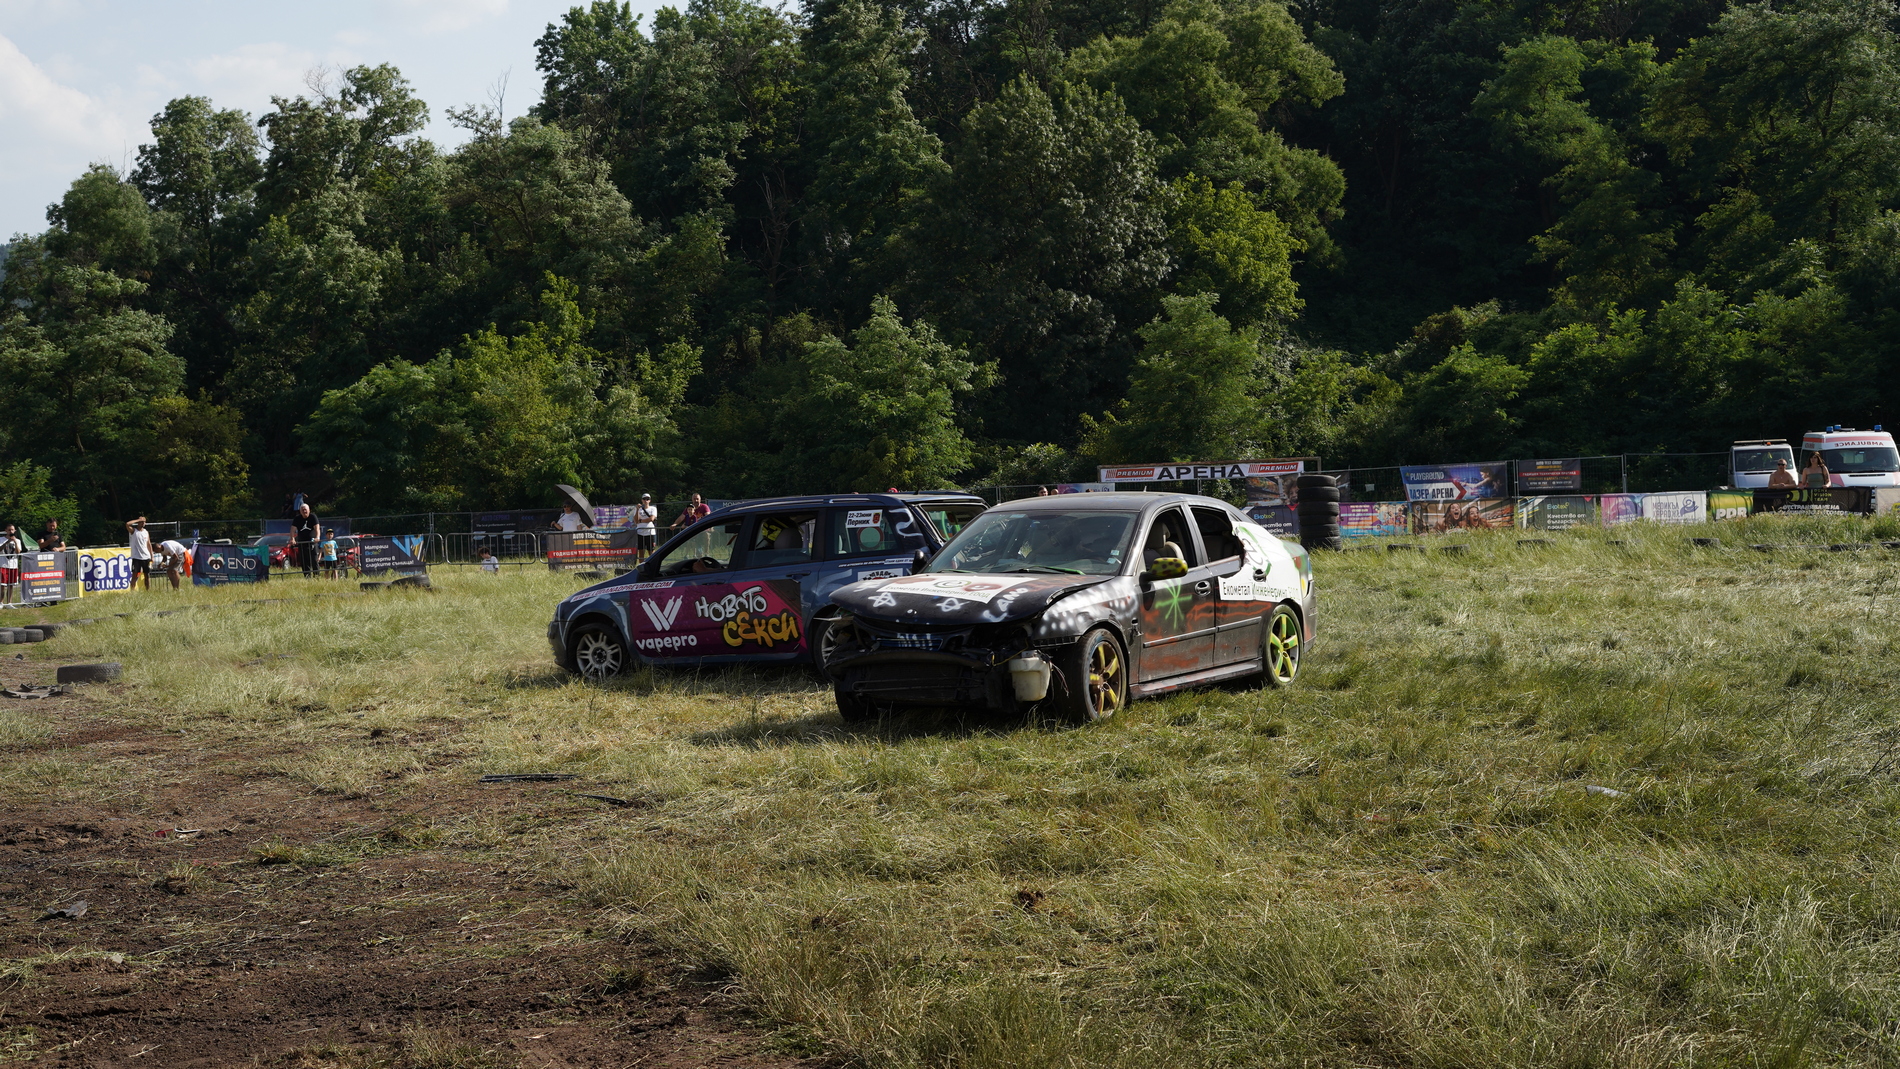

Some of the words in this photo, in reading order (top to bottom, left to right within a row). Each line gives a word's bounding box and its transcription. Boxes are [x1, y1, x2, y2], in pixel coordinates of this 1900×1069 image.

[1157, 464, 1245, 480] АРЕНА
[1259, 464, 1297, 472] PREMIUM
[1410, 471, 1445, 480] PLAYGROUND
[1432, 487, 1454, 499] АРЕНА
[1715, 507, 1748, 520] PDR
[227, 557, 257, 570] ENO
[85, 579, 128, 590] DRINKS
[1222, 581, 1250, 596] Екометал
[695, 586, 767, 622] НОВОТО
[722, 612, 799, 648] СЕКСИ
[635, 634, 698, 652] vapepro
